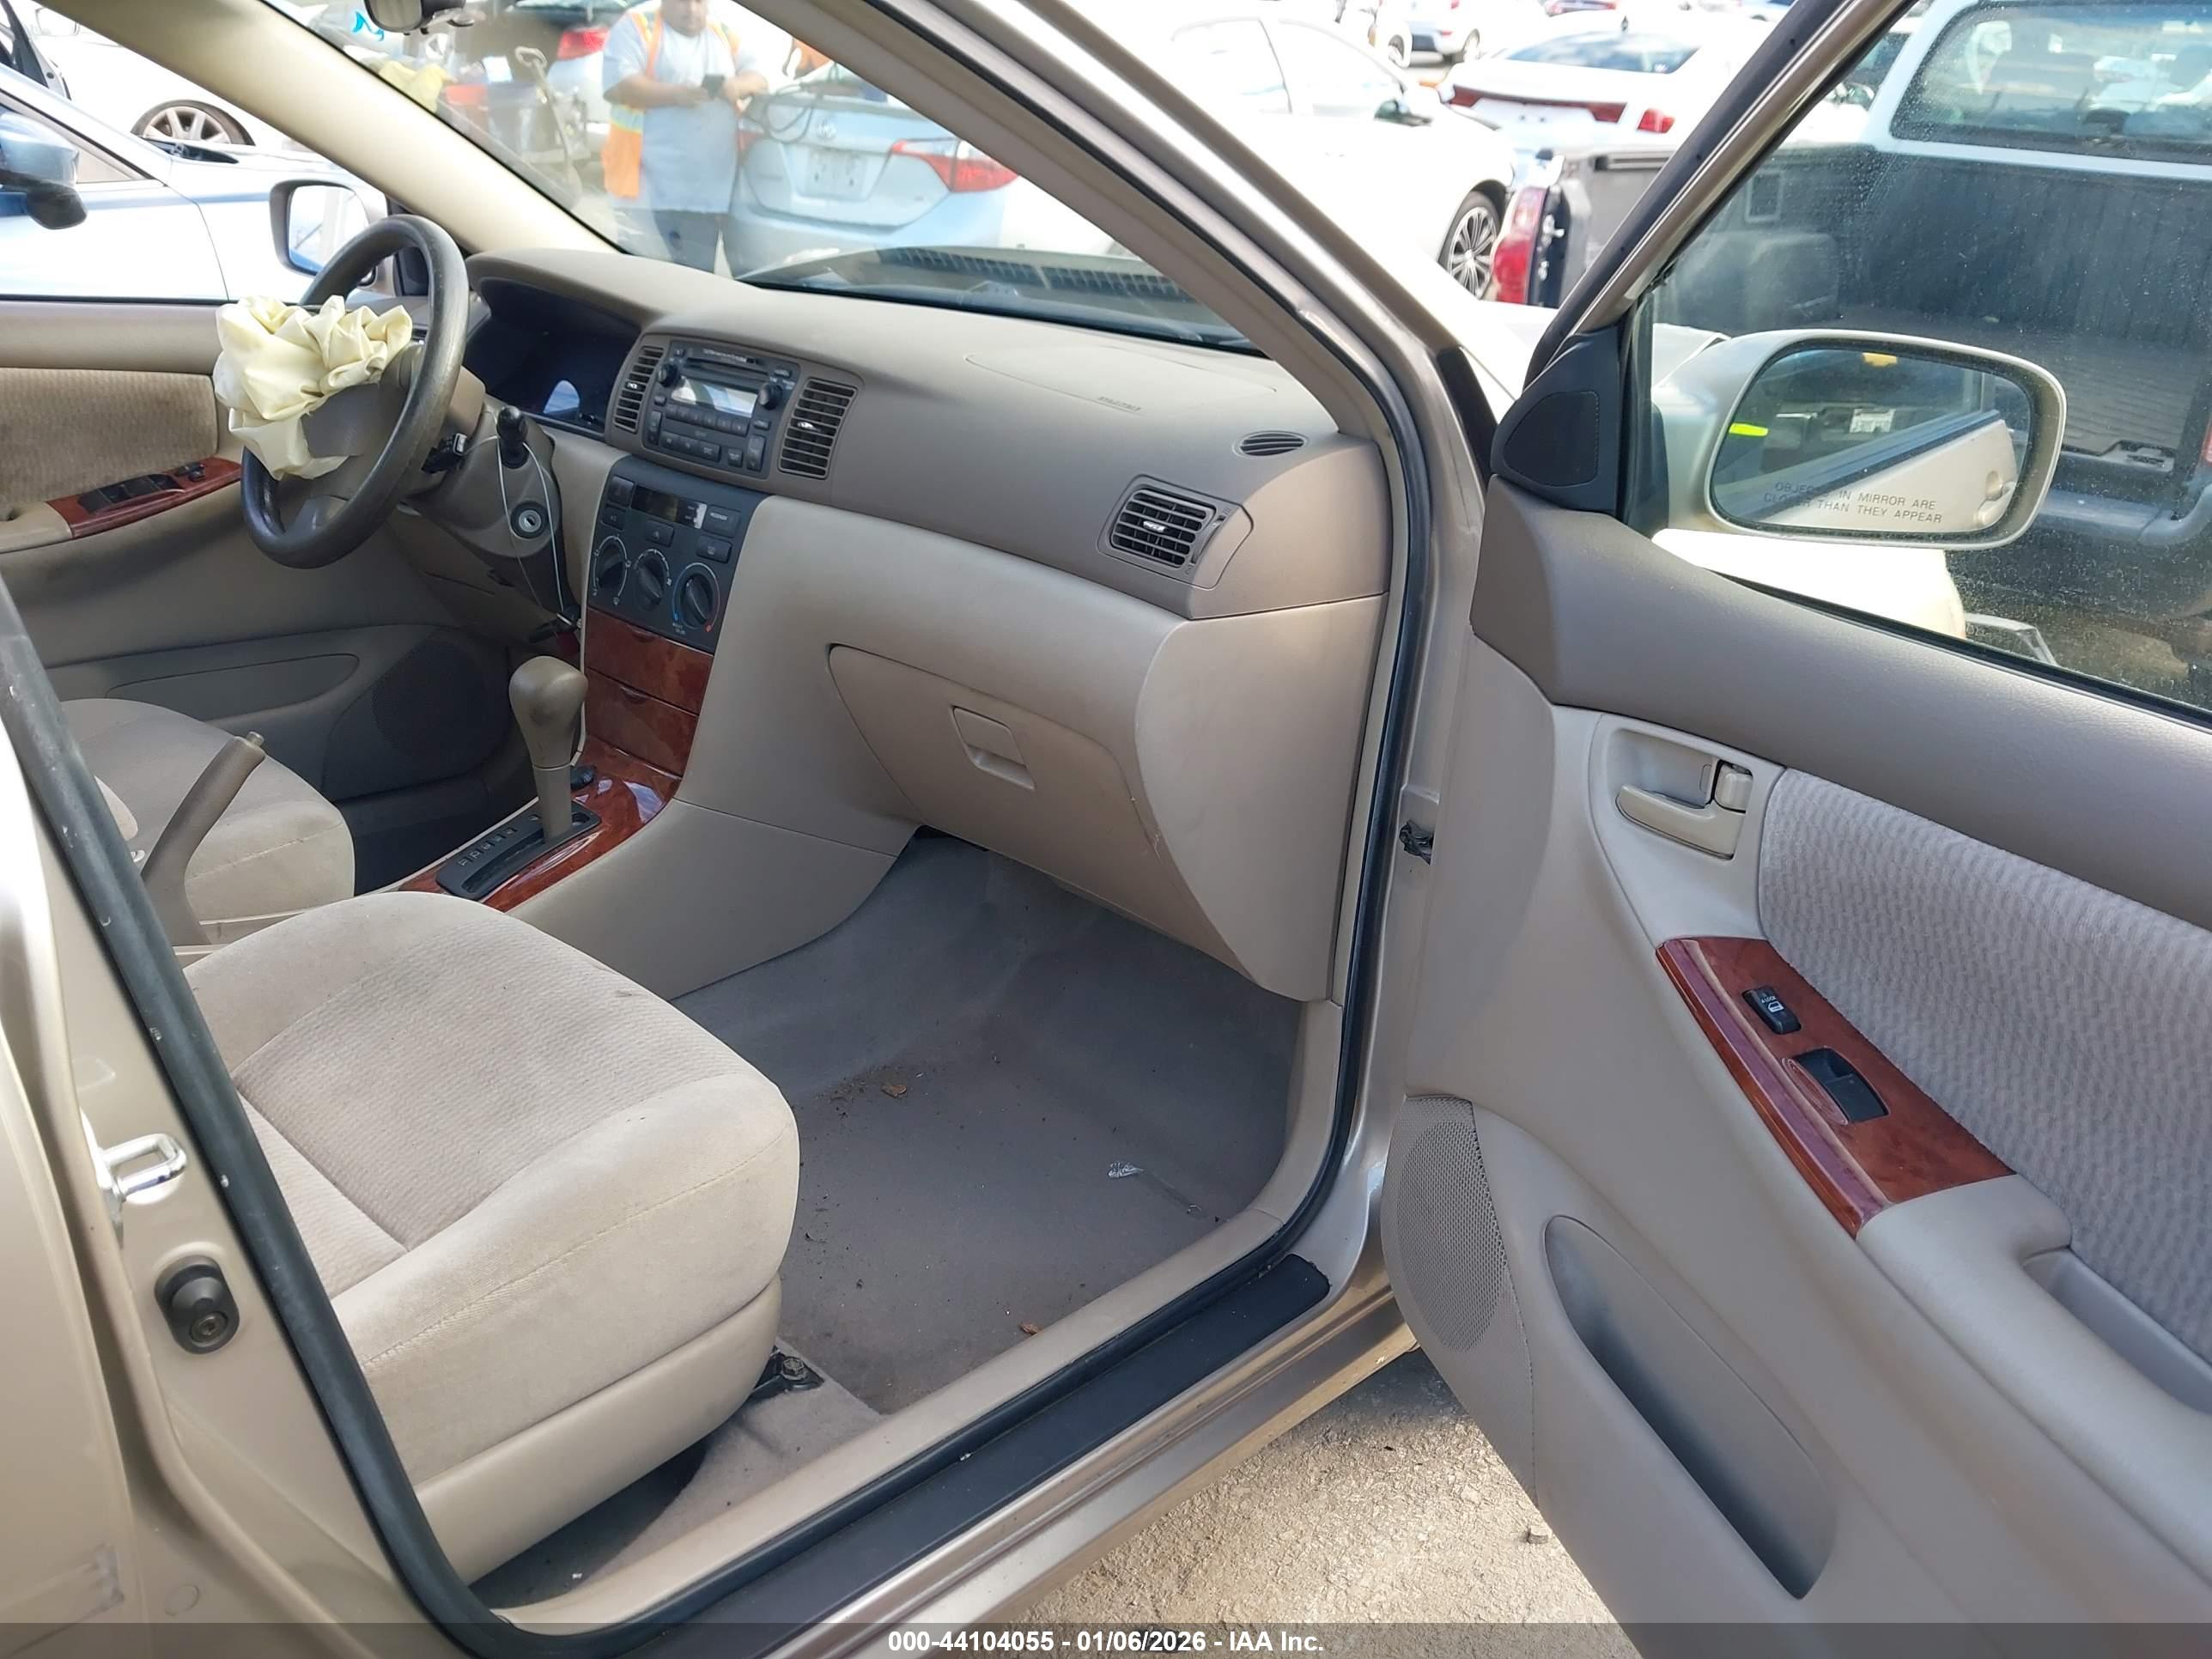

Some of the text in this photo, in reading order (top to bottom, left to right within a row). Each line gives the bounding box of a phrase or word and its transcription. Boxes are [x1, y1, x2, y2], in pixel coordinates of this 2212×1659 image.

[1839, 489, 1852, 501] IN
[1856, 491, 1906, 507] MIRROR
[1911, 498, 1937, 510] ARE
[1816, 499, 1850, 513] THAN
[1856, 504, 1888, 517] THEY
[1893, 509, 1942, 523] APPEAR
